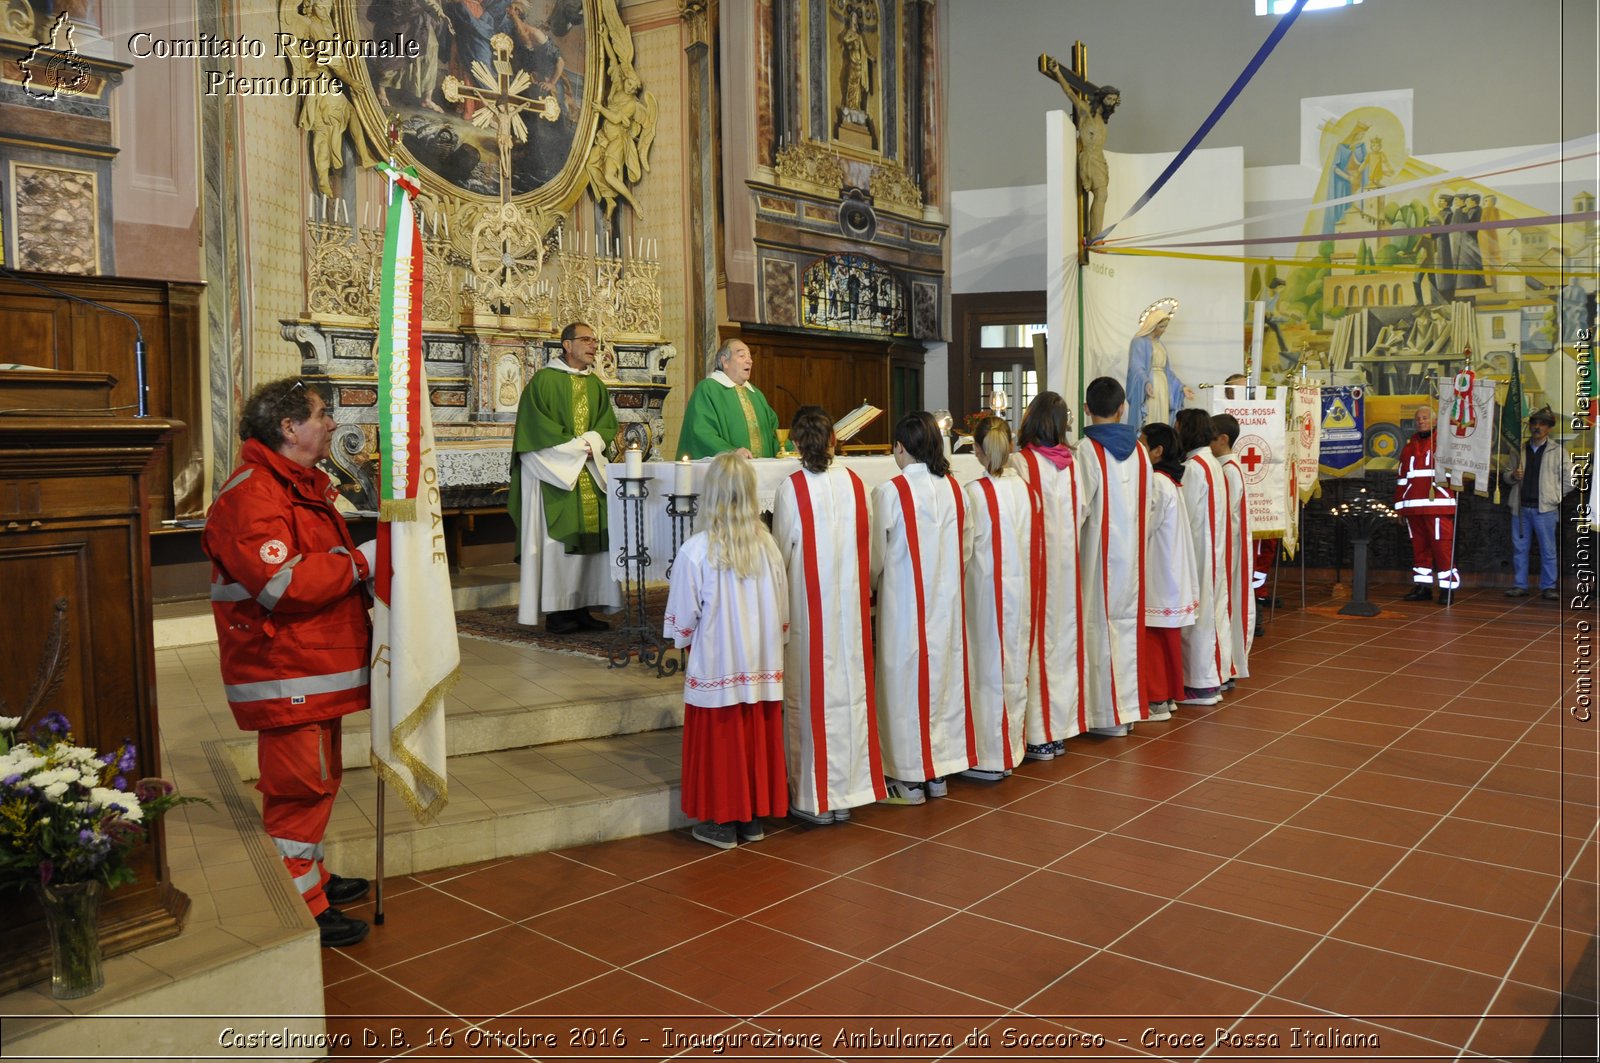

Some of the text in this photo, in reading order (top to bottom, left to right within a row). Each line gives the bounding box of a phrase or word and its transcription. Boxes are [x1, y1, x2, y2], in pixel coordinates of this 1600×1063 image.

[389, 256, 415, 491] CROCE ROSSA ITALIANA
[1224, 408, 1276, 416] CROCE ROSSA
[1237, 418, 1267, 426] TALIANA
